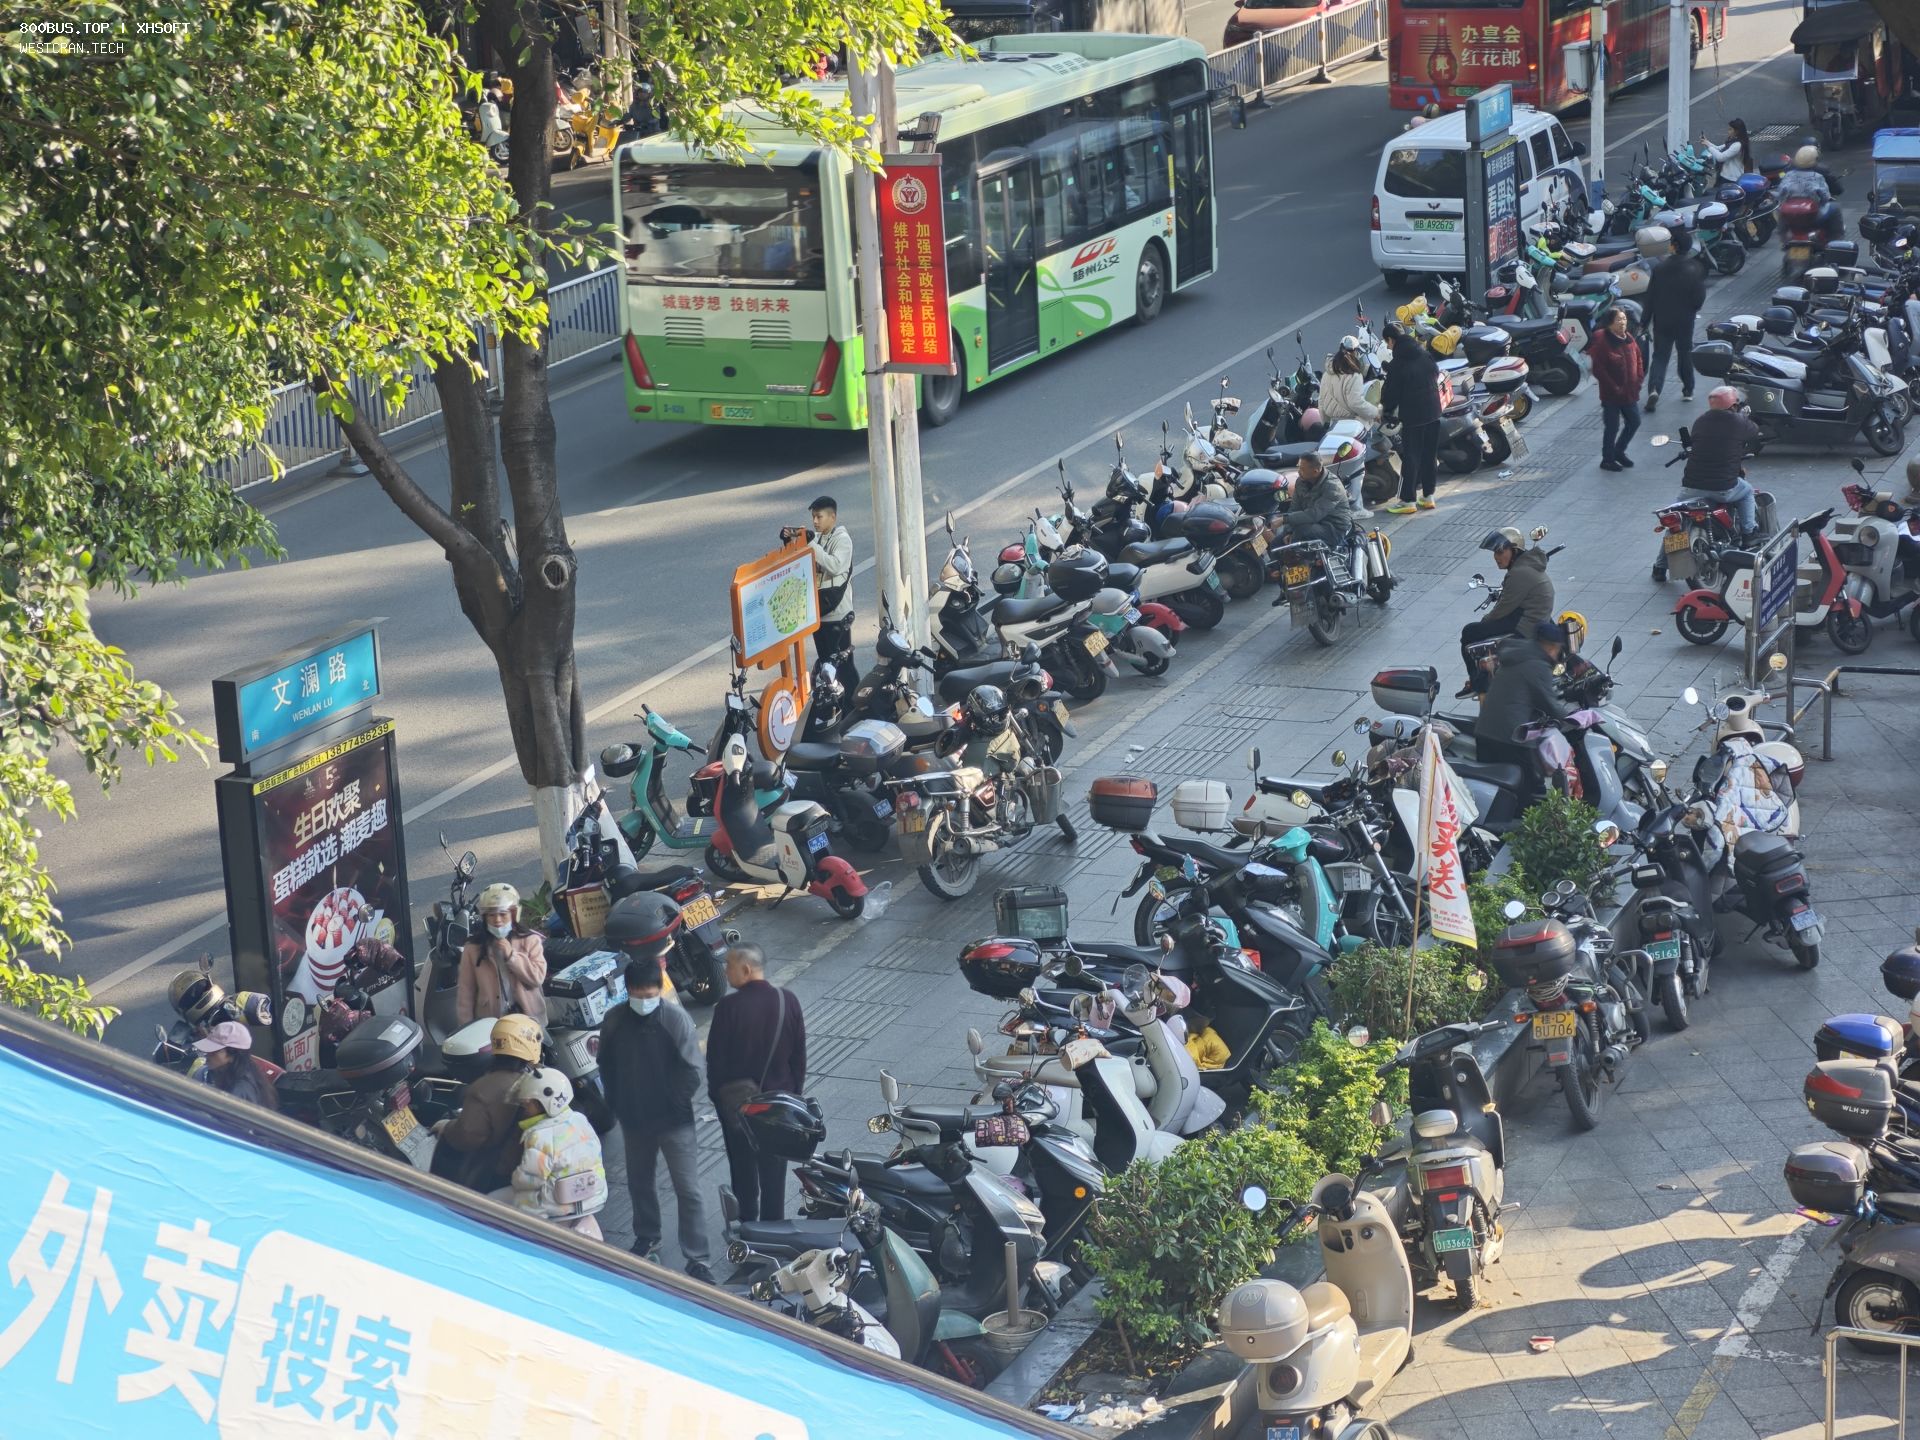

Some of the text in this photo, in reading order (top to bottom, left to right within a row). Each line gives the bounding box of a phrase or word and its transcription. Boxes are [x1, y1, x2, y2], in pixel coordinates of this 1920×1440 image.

[1461, 25, 1521, 43] 办宴会
[1461, 48, 1521, 67] 红花郎
[1427, 219, 1454, 231] A92675
[1073, 254, 1120, 282] 梧州公交
[893, 222, 916, 354] 维护社会和谐稳定
[916, 222, 938, 354] 加强军政军民团结
[662, 295, 791, 313] 城载梦想 投创未来
[272, 652, 347, 712] 文澜路
[362, 679, 370, 691] 北
[292, 698, 333, 722] WENLAN LU
[251, 729, 260, 742] 南
[325, 722, 389, 760] 13877486239
[293, 779, 361, 849] 生日欢聚
[273, 799, 388, 905] 蛋糕就选 潮麦趣
[1541, 1013, 1567, 1025] 桂·D
[1535, 1023, 1573, 1038] BU706
[1841, 1104, 1859, 1114] WLH
[1436, 1237, 1471, 1250] 0133662
[0, 1170, 241, 1425] 外卖
[255, 1283, 412, 1438] 搜索
